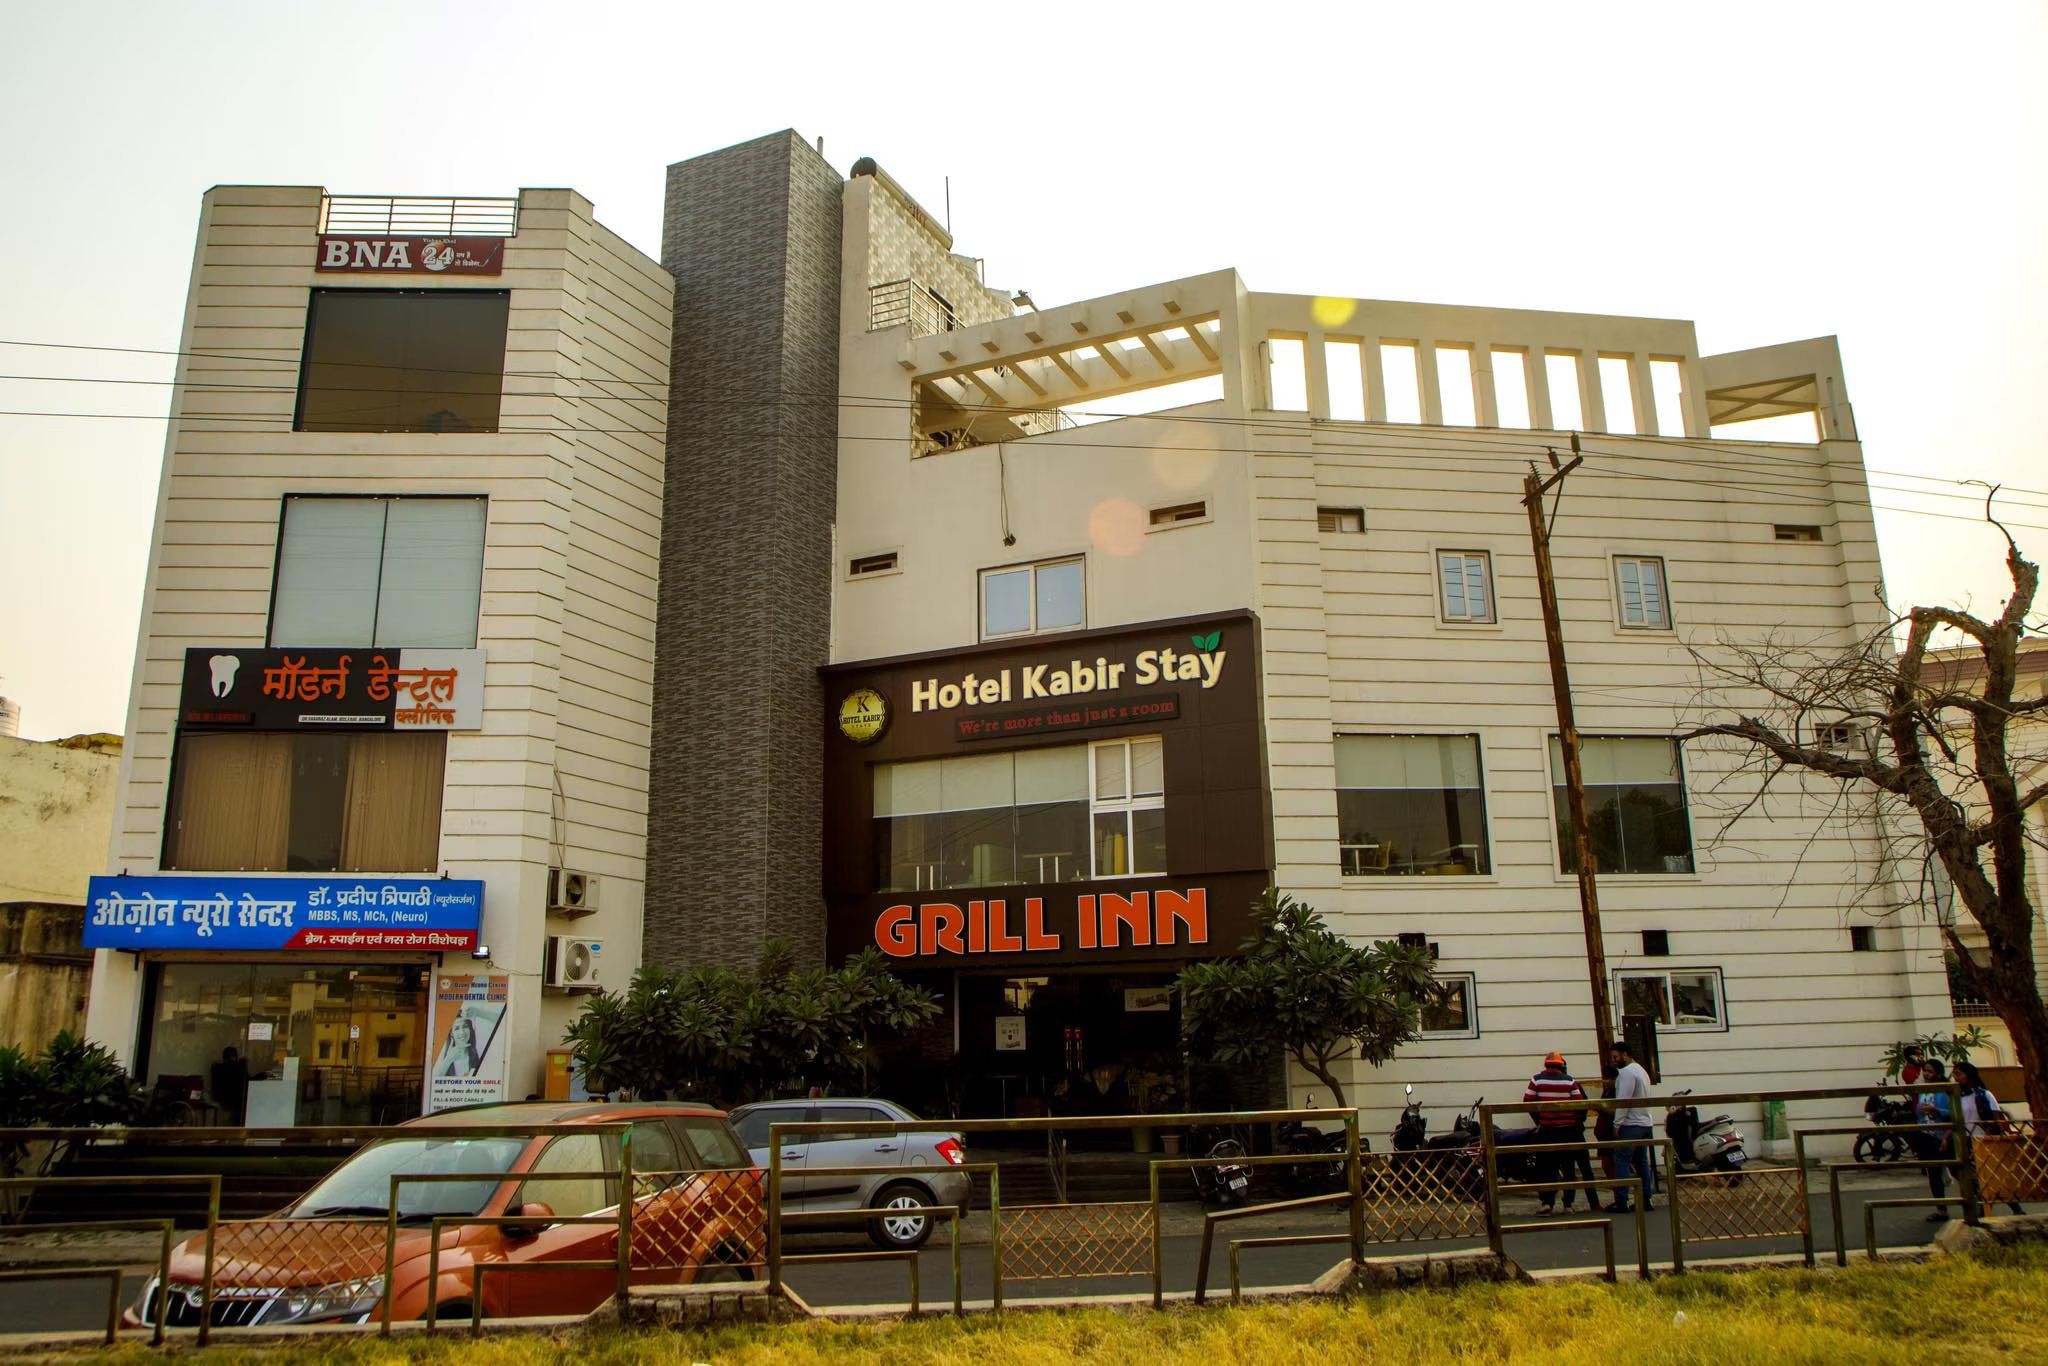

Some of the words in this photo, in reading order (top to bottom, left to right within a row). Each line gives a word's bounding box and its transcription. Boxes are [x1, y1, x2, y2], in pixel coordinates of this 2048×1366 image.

[322, 240, 413, 268] BNA
[423, 247, 451, 265] 24
[262, 655, 352, 701] मॉडर्न
[367, 655, 458, 702] डेन्टल
[911, 668, 1011, 713] Hotel
[1022, 656, 1126, 700] Kabir
[1135, 647, 1228, 688] Stay
[395, 702, 456, 725] क्लीनिक
[857, 696, 869, 713] K
[959, 720, 999, 734] We're
[1004, 716, 1042, 731] more
[1046, 710, 1081, 726] than
[1083, 705, 1117, 726] just
[1132, 700, 1175, 717] room
[842, 715, 861, 724] HOTEL
[863, 714, 881, 723] KABIR
[308, 886, 332, 907] डॉ.
[336, 885, 378, 907] प्रदीप
[380, 885, 431, 907] त्रिपाठी
[181, 892, 234, 937] न्यूरो
[237, 892, 297, 928] सेन्टर
[308, 910, 340, 923] MBBS,
[343, 910, 361, 923] MS,
[364, 910, 388, 924] MCh,
[391, 911, 428, 924] (Neuro)
[874, 898, 1060, 957] GRILL
[1078, 888, 1208, 949] INN
[366, 932, 383, 946] एवं
[406, 933, 427, 945] रोग
[428, 932, 469, 947] विशेषज्ञ
